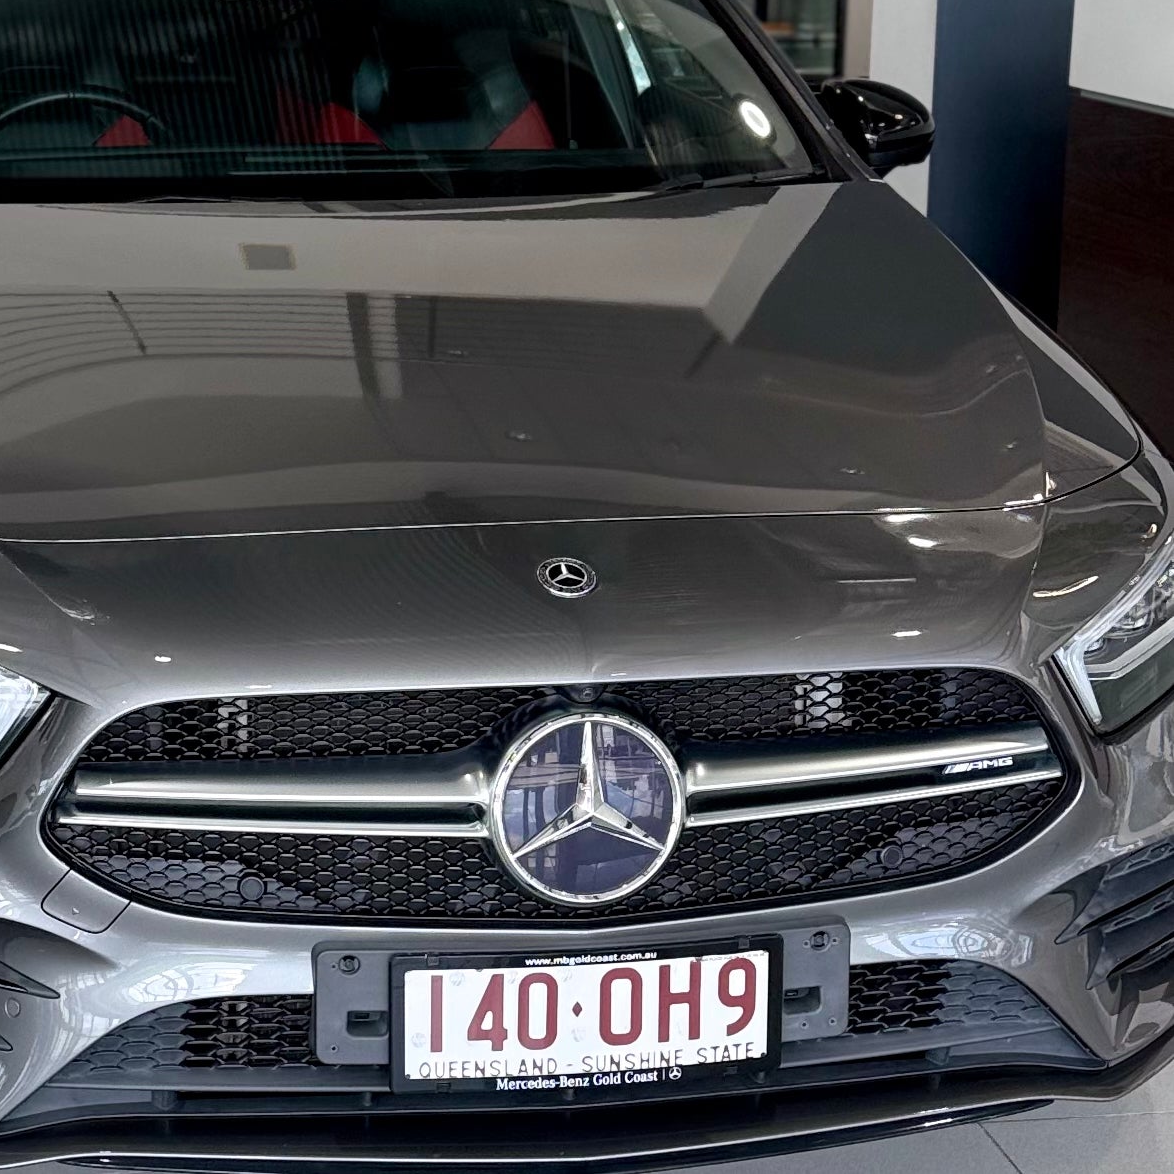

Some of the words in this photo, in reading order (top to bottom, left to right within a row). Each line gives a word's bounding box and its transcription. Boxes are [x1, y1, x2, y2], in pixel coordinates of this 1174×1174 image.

[525, 952, 658, 966] www.mbgoldcoast.com.au
[419, 1057, 558, 1080] QUEENSLAND
[582, 1049, 684, 1073] SUNSHINE
[697, 1042, 755, 1065] STATE
[495, 1076, 590, 1091] Mercedes-Benz
[593, 1072, 622, 1087] Gold
[624, 1070, 658, 1084] Coast
